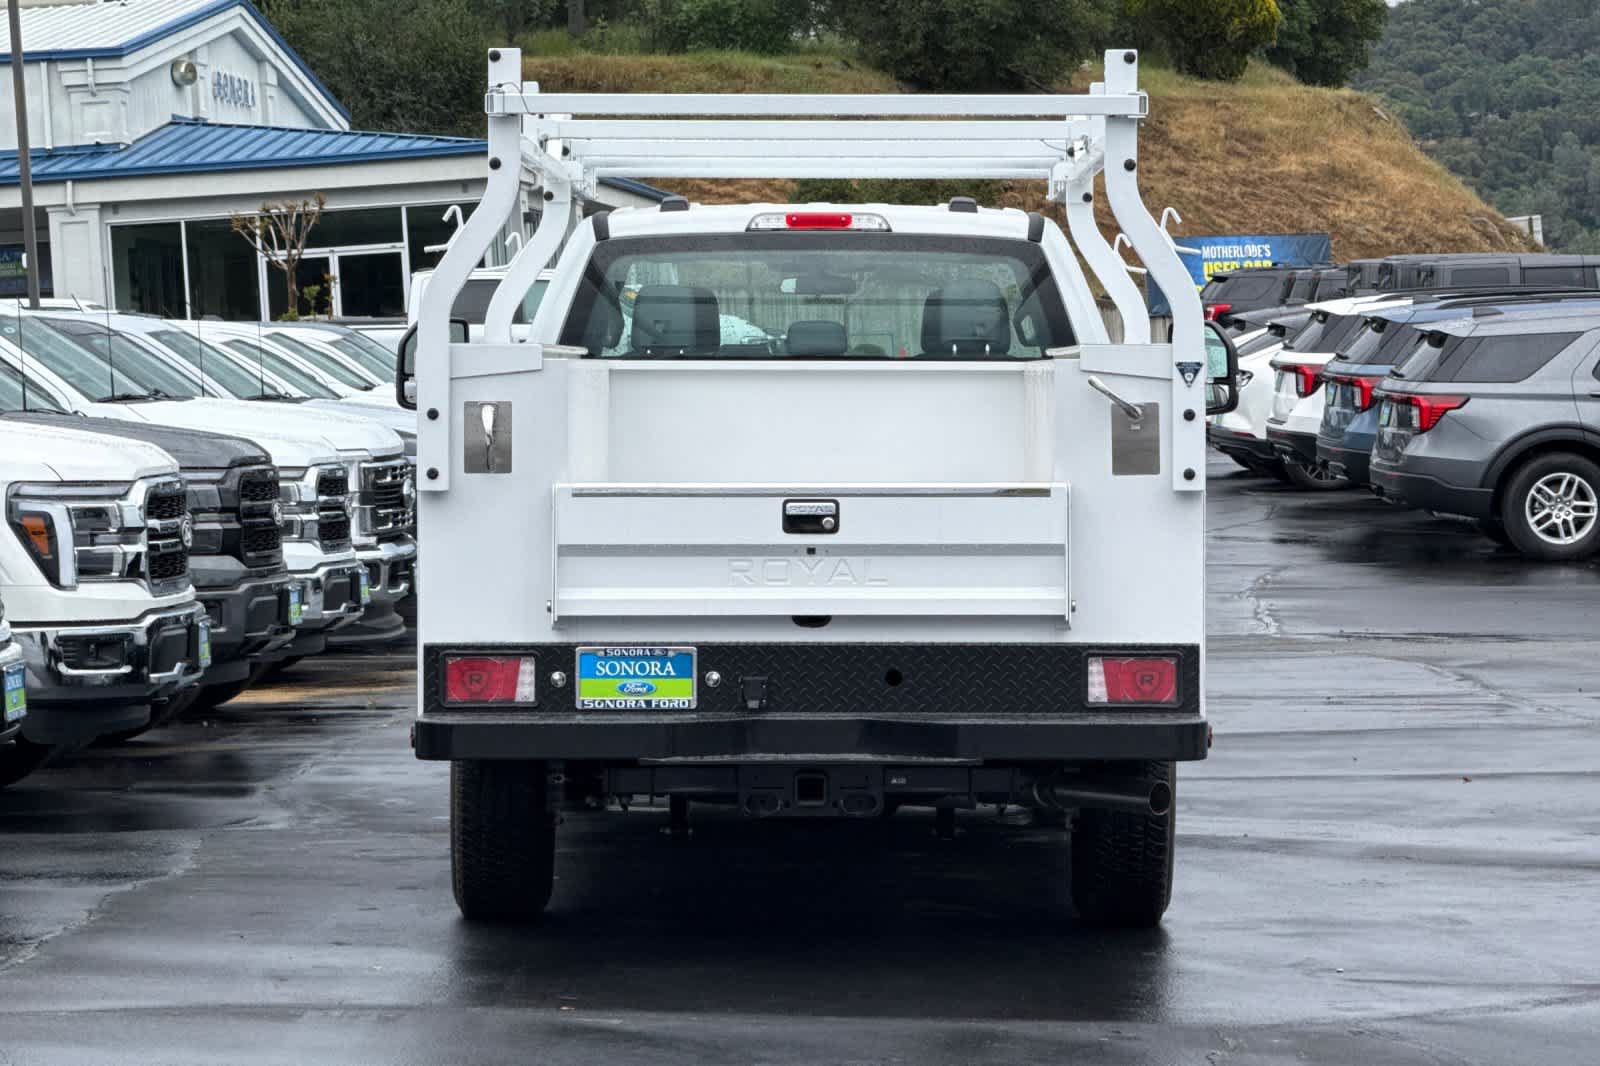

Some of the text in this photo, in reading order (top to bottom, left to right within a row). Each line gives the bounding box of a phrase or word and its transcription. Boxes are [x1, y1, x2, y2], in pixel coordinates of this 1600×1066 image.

[1202, 244, 1271, 259] MOTHERLODE'S
[727, 558, 889, 585] ROYAL
[606, 648, 651, 656] SONORA
[595, 660, 676, 676] SONORA
[583, 700, 689, 708] SONORA FORD
